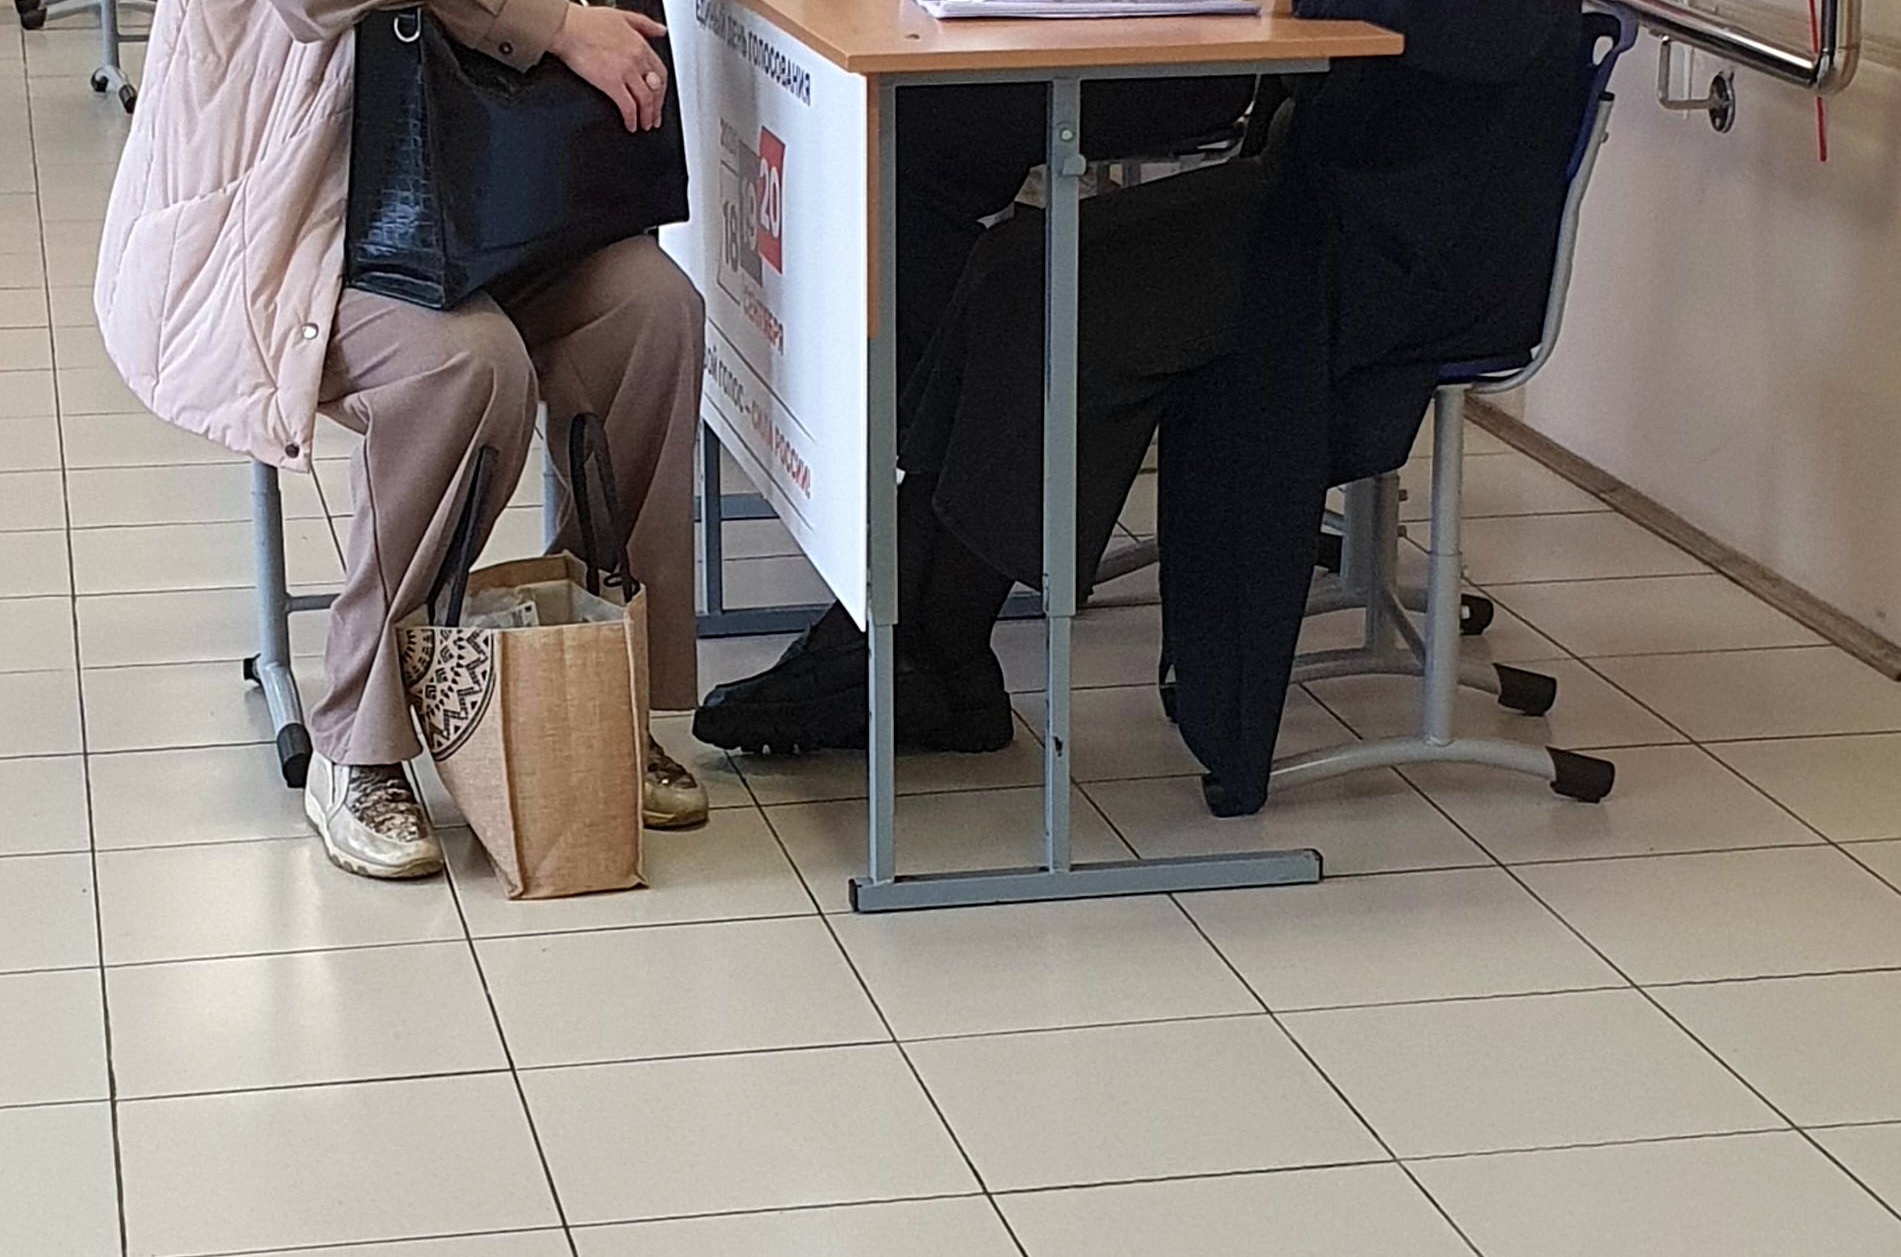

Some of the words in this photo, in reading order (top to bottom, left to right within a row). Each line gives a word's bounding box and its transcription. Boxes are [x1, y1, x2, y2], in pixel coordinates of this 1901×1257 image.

[747, 29, 811, 108] ГОЛОСОВАНИЯ
[722, 200, 739, 273] 18
[759, 157, 780, 239] 20
